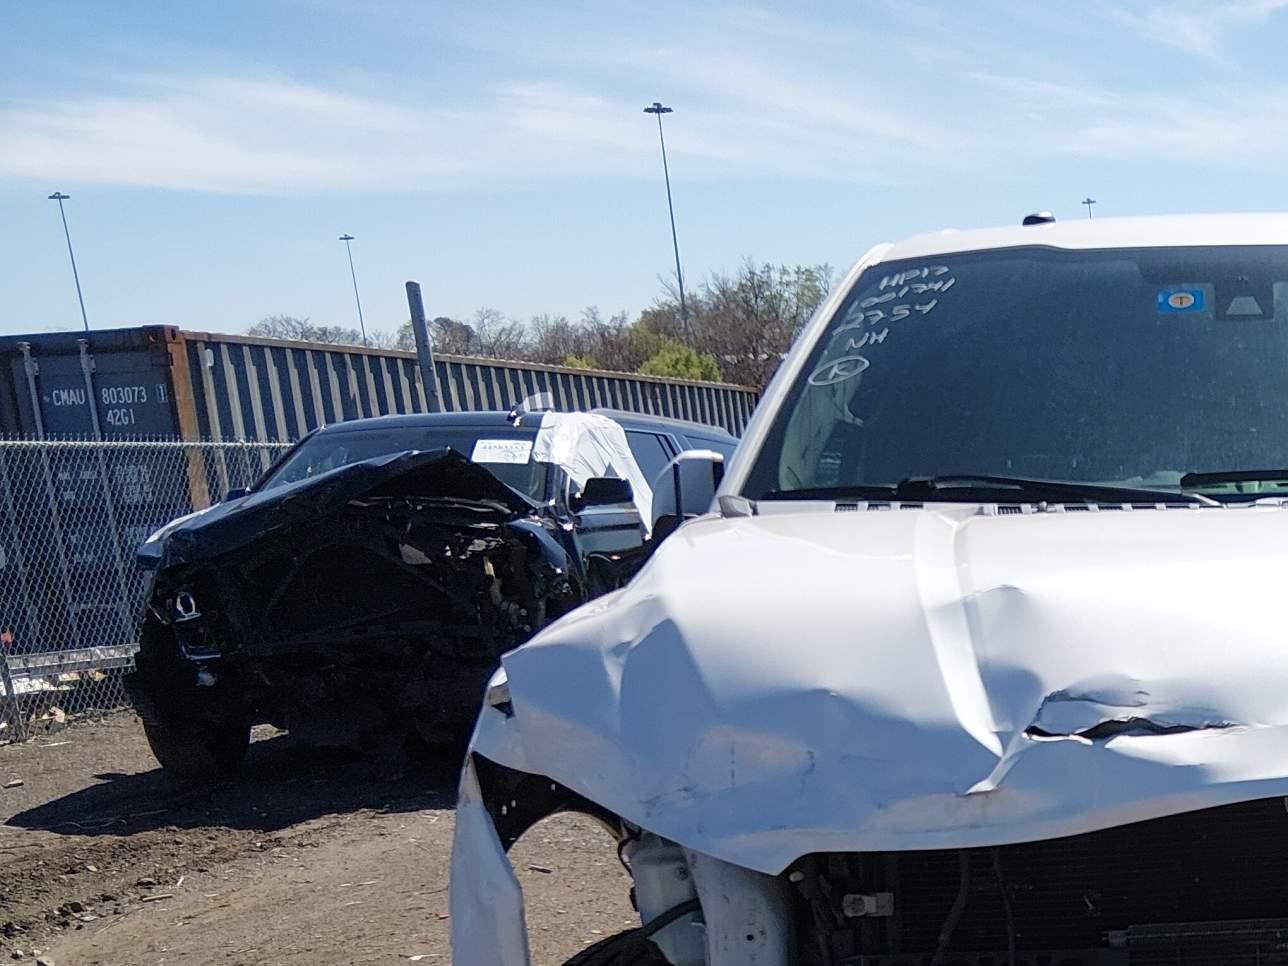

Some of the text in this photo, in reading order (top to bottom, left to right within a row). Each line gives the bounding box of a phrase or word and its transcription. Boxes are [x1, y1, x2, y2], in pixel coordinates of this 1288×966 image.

[52, 388, 86, 406] CMAU
[101, 386, 148, 405] 803073
[106, 408, 135, 426] 42G1
